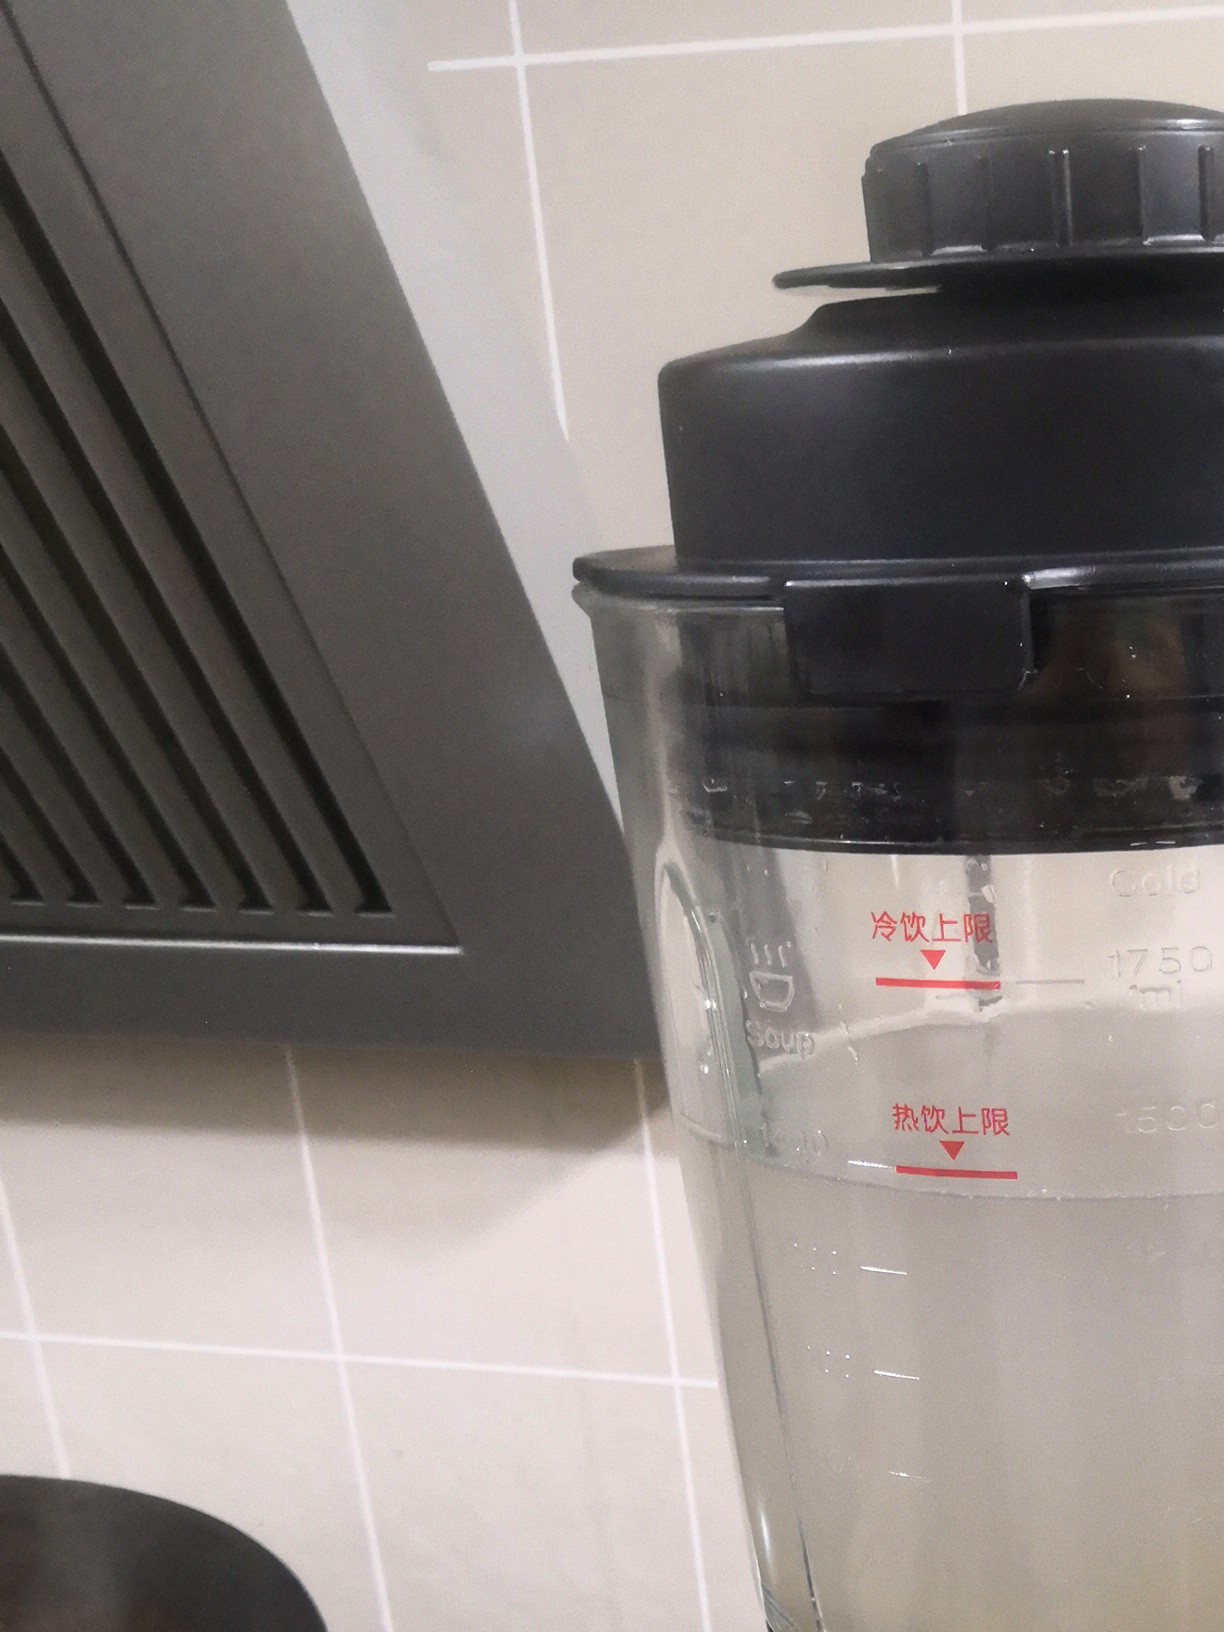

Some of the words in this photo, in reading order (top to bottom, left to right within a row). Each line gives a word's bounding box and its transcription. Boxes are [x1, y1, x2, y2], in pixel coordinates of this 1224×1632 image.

[870, 911, 991, 943] 冷饮上限
[1106, 944, 1215, 980] 1750
[891, 1103, 1011, 1136] 热饮上限
